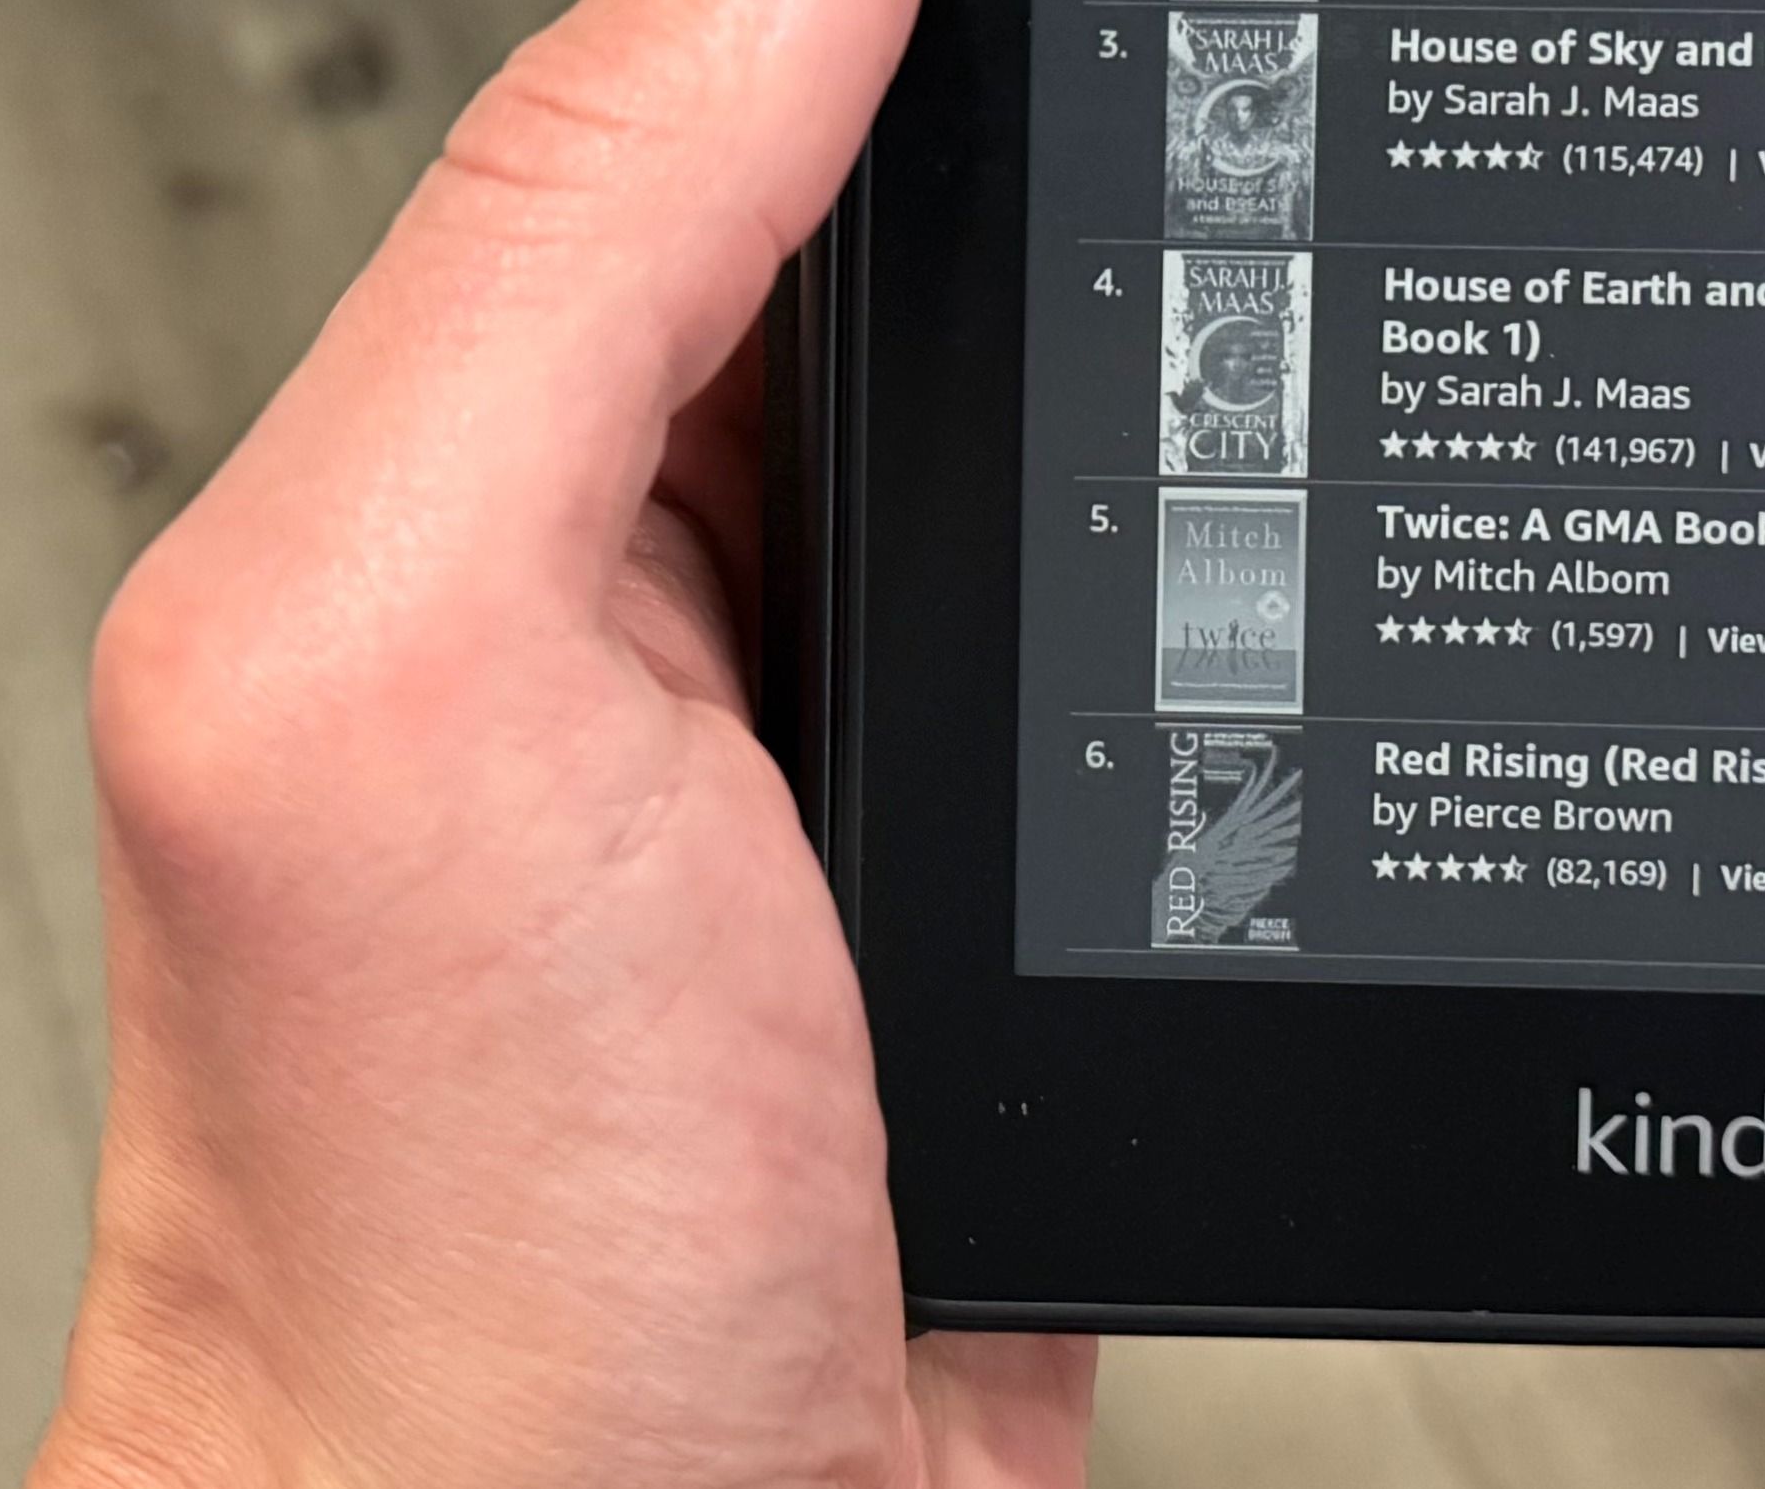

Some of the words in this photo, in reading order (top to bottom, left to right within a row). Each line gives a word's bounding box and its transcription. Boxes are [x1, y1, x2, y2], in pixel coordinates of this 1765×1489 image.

[1098, 29, 1128, 59] 3.
[1195, 28, 1271, 51] SARAH
[1390, 28, 1518, 64] House
[1530, 28, 1577, 65] of
[1588, 30, 1664, 75] Sky
[1675, 31, 1753, 67] and
[1204, 52, 1279, 74] MAAS
[1388, 79, 1434, 124] by
[1444, 81, 1550, 117] Sarah
[1560, 85, 1590, 117] J.
[1604, 85, 1700, 118] Maas
[1562, 143, 1704, 177] (115,474)
[1093, 267, 1123, 297] 4.
[1189, 266, 1268, 289] SARAH
[1384, 267, 1512, 303] House
[1524, 267, 1571, 304] of
[1582, 270, 1691, 306] Earth
[1198, 291, 1275, 314] MAAS
[1382, 319, 1489, 355] Book
[1503, 319, 1541, 363] 1)
[1381, 370, 1427, 414] by
[1437, 373, 1542, 408] Sarah
[1552, 376, 1582, 408] J.
[1596, 377, 1691, 410] Maas
[1189, 414, 1277, 429] CRESCENT
[1188, 429, 1278, 460] CITY
[1555, 434, 1696, 468] (141,967)
[1089, 504, 1118, 533] 5.
[1185, 520, 1283, 550] Mitch
[1376, 503, 1510, 541] Twice:
[1520, 507, 1552, 542] A
[1564, 508, 1663, 544] GMA
[1177, 558, 1286, 587] Albom
[1377, 555, 1422, 599] by
[1434, 558, 1535, 592] Mitch
[1546, 559, 1670, 596] Albom
[1551, 620, 1654, 653] (1,597)
[1085, 740, 1114, 770] 6.
[1375, 741, 1451, 776] Red
[1465, 742, 1589, 789] Rising
[1604, 744, 1698, 787] (Red
[1373, 792, 1418, 836] by
[1430, 794, 1541, 830] Pierce
[1553, 799, 1673, 833] Brown
[1546, 857, 1667, 891] (82,169)
